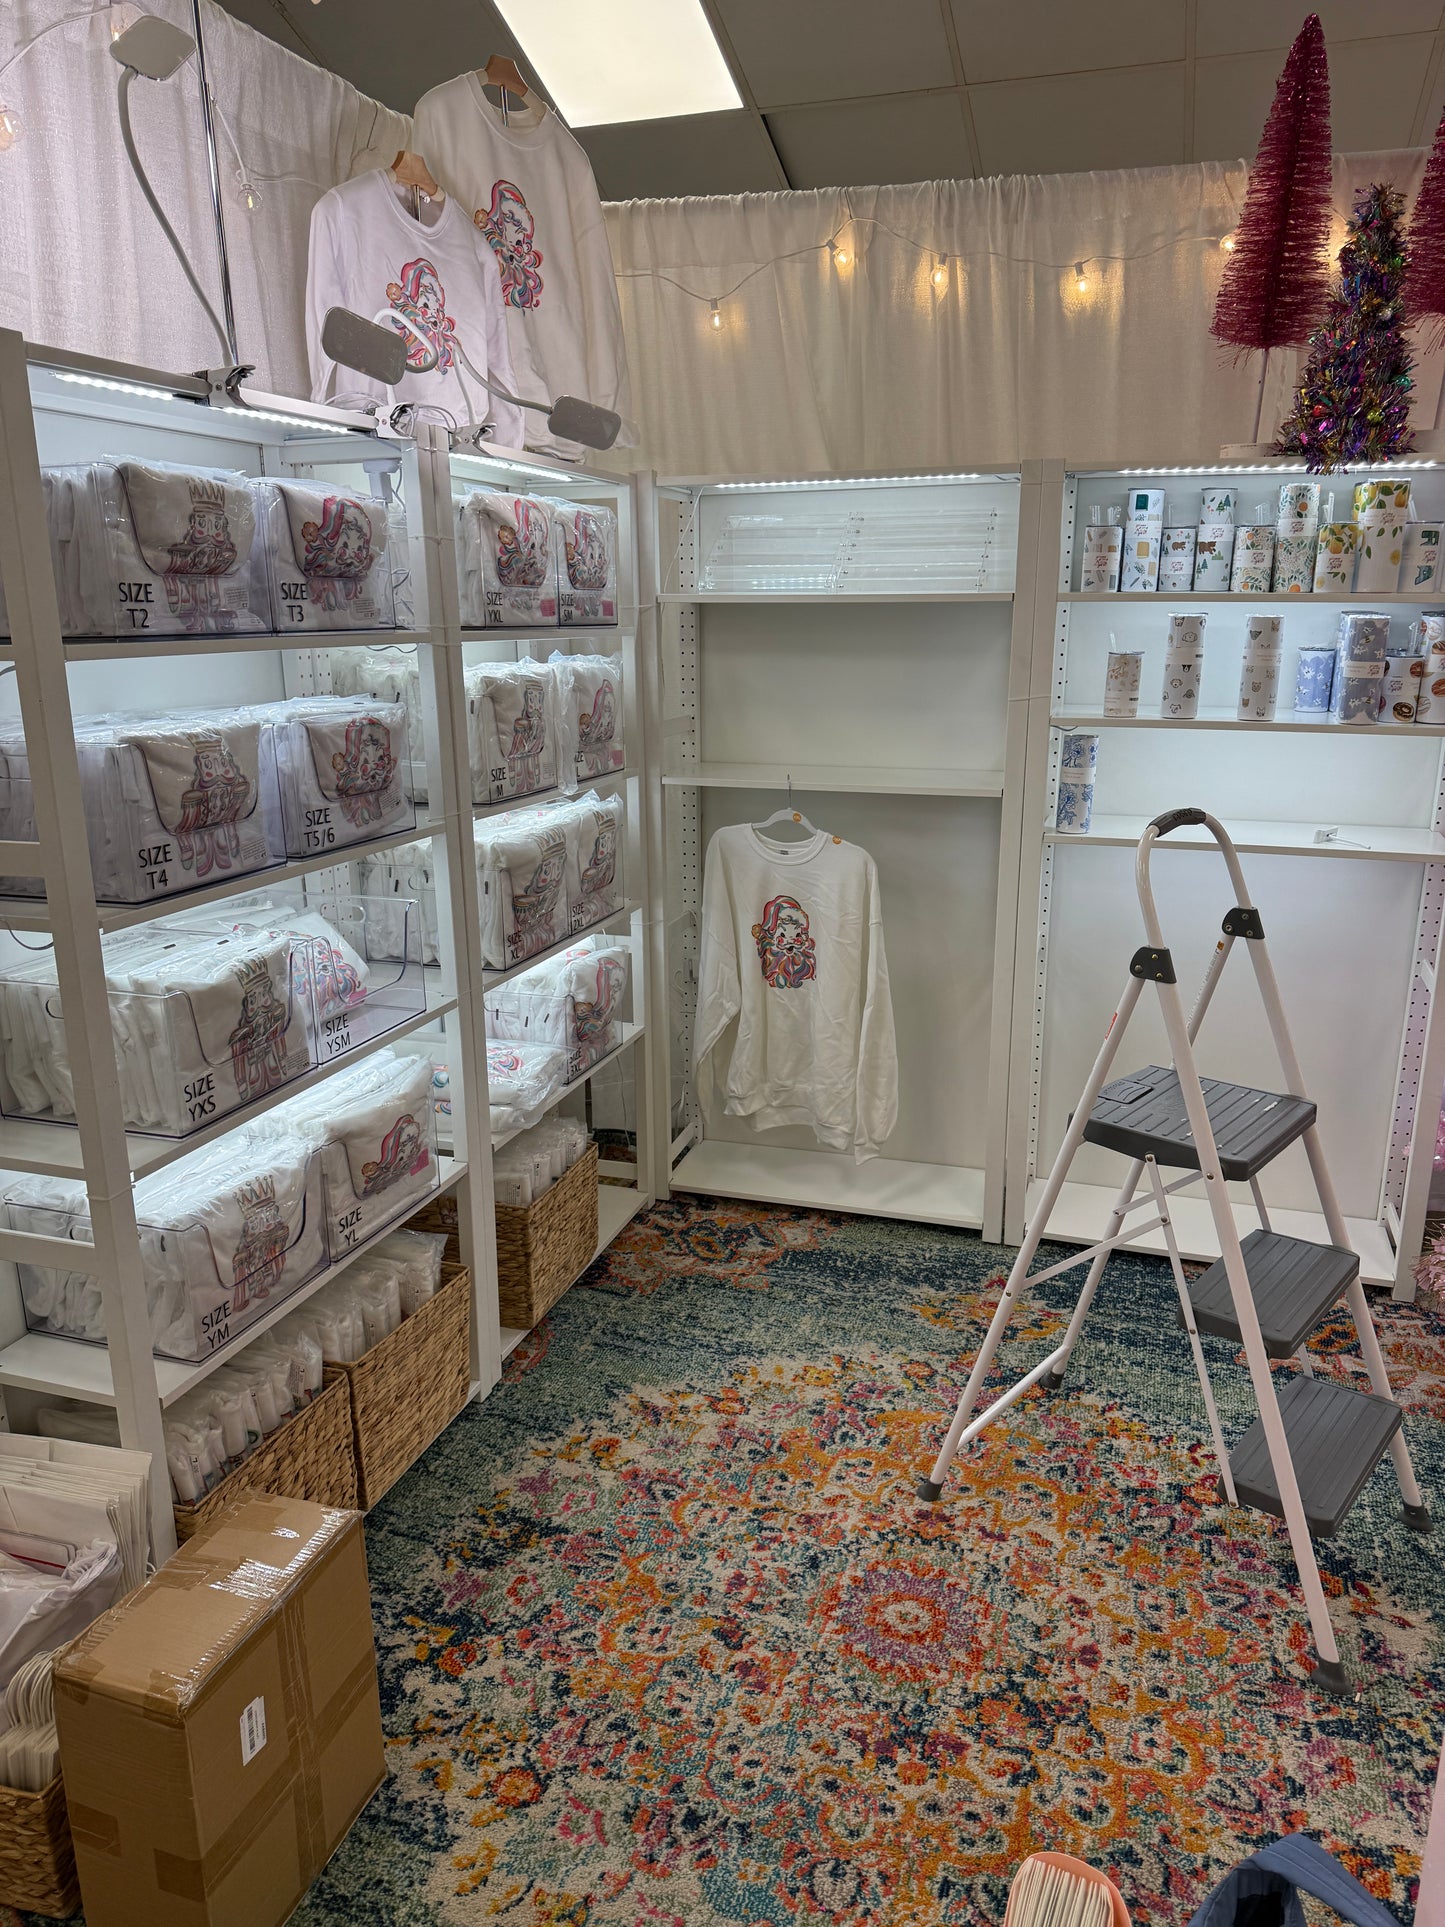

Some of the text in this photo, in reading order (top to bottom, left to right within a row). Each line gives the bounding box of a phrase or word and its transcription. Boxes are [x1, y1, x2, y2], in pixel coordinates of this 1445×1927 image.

[118, 582, 154, 603] SIZE
[281, 582, 308, 600] SIZE
[486, 591, 503, 606] SIZE
[560, 593, 575, 607] SIZE
[126, 608, 150, 628] T2
[286, 604, 304, 622] T3
[487, 608, 504, 623] YXL
[573, 750, 584, 763] IZE
[491, 766, 507, 782] SIZE
[496, 783, 504, 797] M
[305, 807, 331, 828] SIZE
[303, 827, 335, 848] T5/6
[138, 843, 173, 868] SIZE
[146, 868, 169, 890] T4
[572, 902, 585, 918] SIZE
[573, 916, 585, 931] 2XL
[507, 930, 522, 948] SIZE
[510, 947, 520, 961] XL
[325, 1013, 350, 1037] SIZE
[326, 1031, 351, 1055] YSM
[183, 1072, 216, 1103] SIZE
[188, 1094, 217, 1122] YXS
[338, 1206, 363, 1234] SIZE
[344, 1229, 360, 1246] YL
[201, 1300, 232, 1334] SIZE
[207, 1323, 230, 1349] YM
